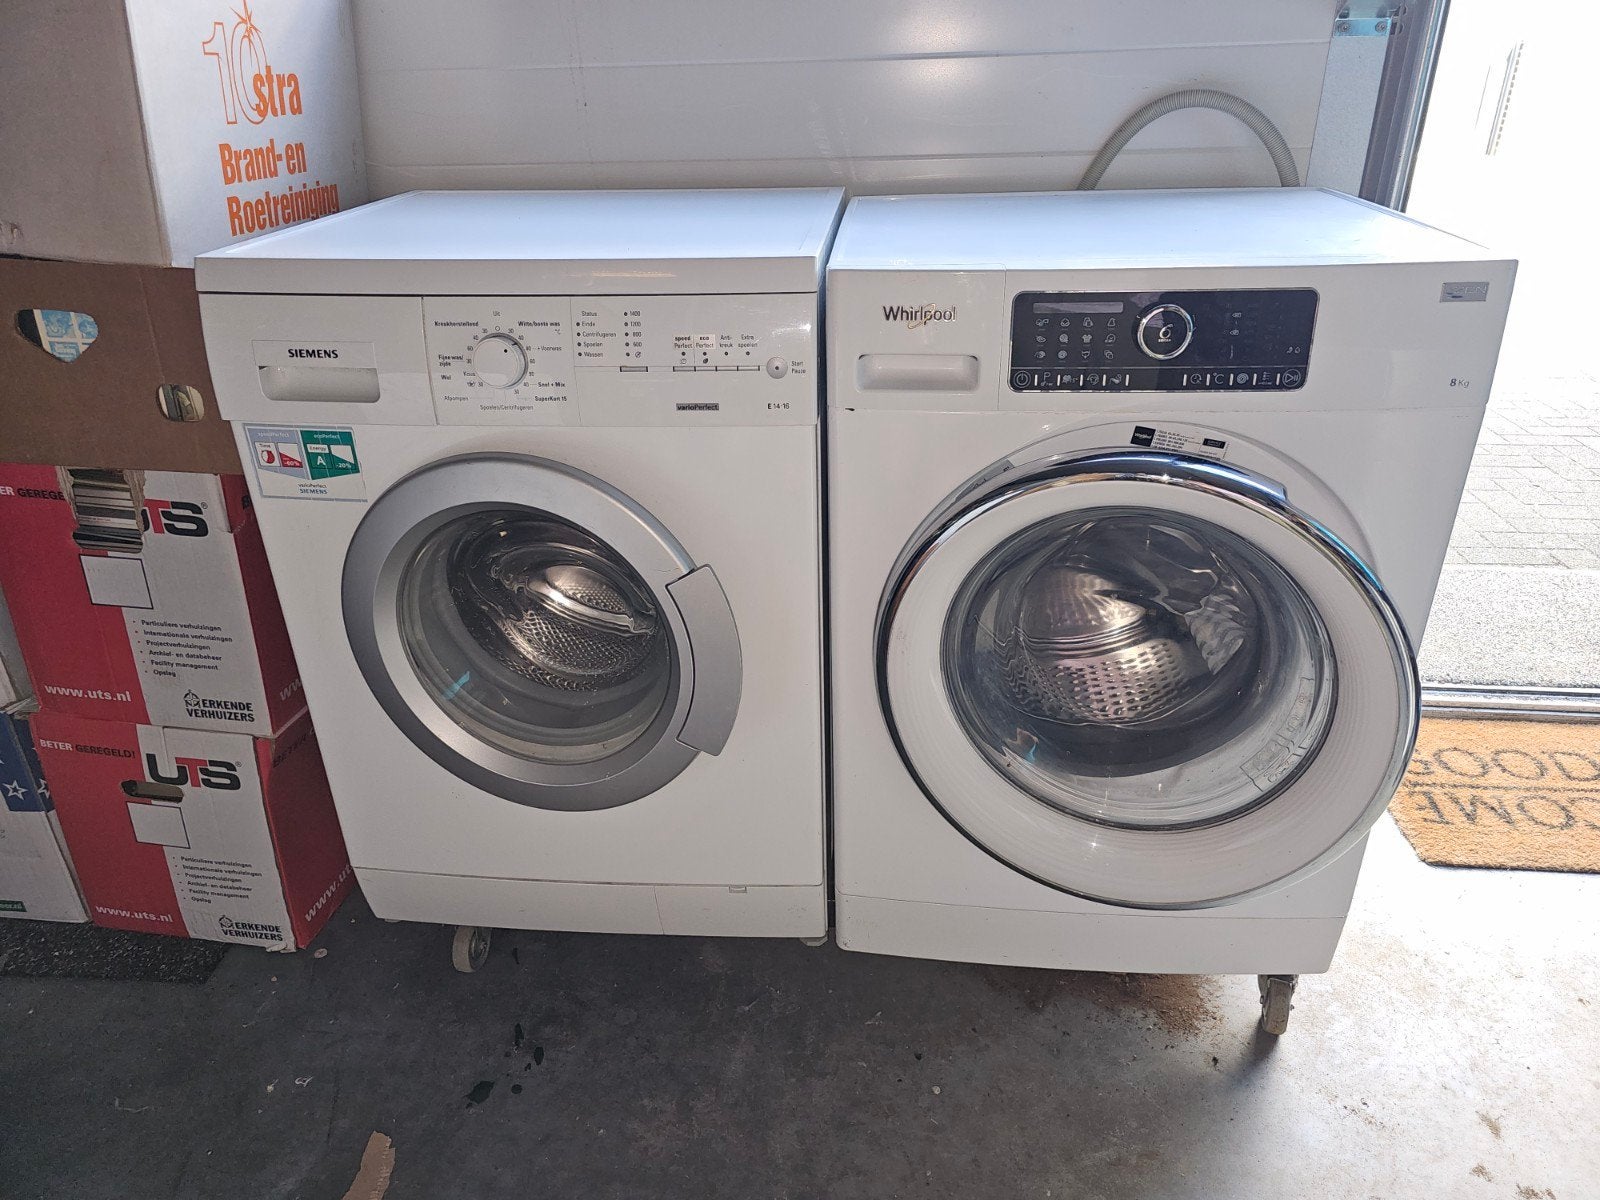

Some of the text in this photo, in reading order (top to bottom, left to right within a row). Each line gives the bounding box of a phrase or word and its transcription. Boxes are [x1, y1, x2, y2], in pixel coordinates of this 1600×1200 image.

[882, 304, 957, 327] Whirlpool
[288, 348, 339, 359] SIEMENS
[1449, 378, 1470, 389] 8 Kg
[316, 455, 327, 466] A
[142, 498, 209, 538] TS
[141, 619, 222, 632] Particuliere verhuizingen
[143, 630, 233, 643] Internationale verhuizingen
[146, 640, 211, 650] Projectverhuizingen
[185, 653, 222, 662] databeheer
[150, 659, 219, 671] Facility management
[153, 669, 177, 678] Opslag
[44, 684, 132, 702] www.uts.nl
[201, 698, 254, 712] ERKENDE
[185, 707, 255, 723] VERHUIZERS
[39, 738, 136, 759] BETER GEREGELD!
[145, 753, 241, 791] UTS
[182, 864, 263, 878] Internationale verhuizingen
[214, 860, 252, 869] verhuizingen
[185, 872, 242, 883] Projectverhuizingen
[191, 896, 212, 904] Opslag
[95, 903, 174, 923] www.uts.nl
[234, 922, 282, 933] ERKENDE
[221, 928, 283, 942] VERHUIZERS
